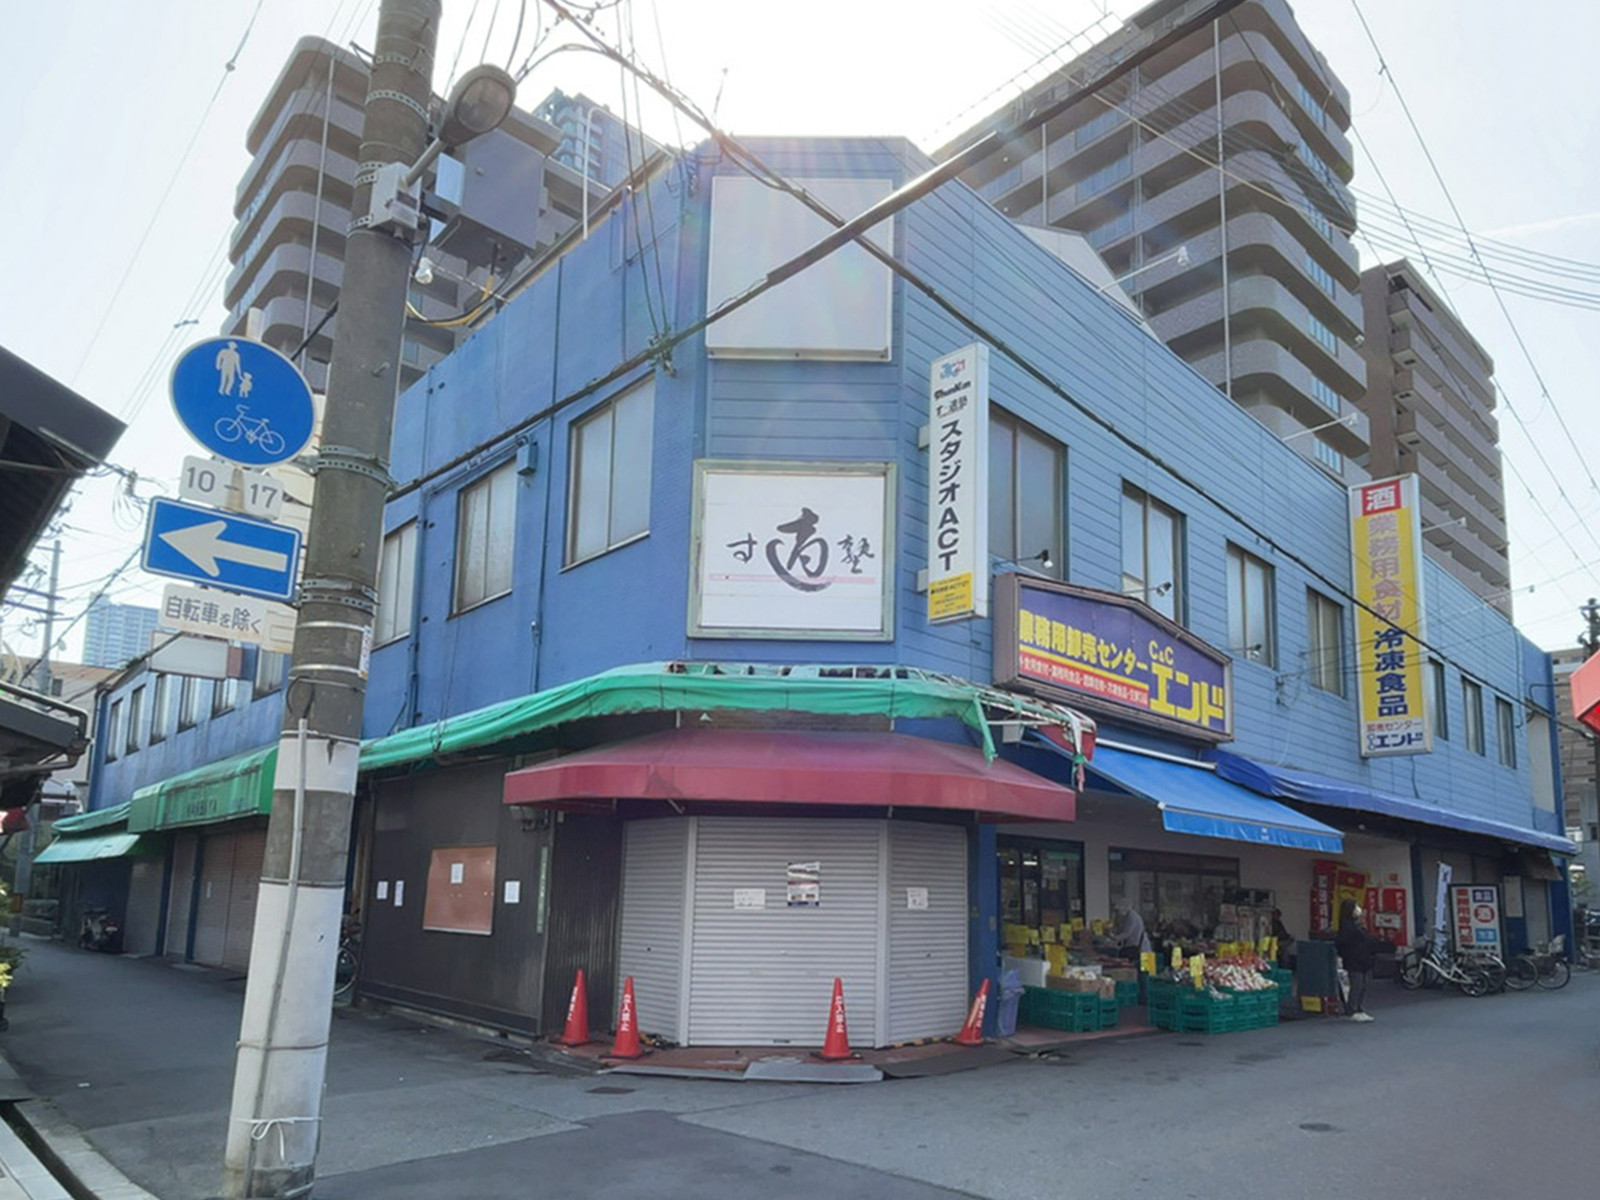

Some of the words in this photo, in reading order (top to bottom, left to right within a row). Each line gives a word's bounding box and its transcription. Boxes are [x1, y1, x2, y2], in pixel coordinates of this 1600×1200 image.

[938, 419, 962, 571] スタジオACT
[1365, 484, 1396, 512] 酒
[165, 596, 262, 635] 自転車を除く
[1150, 661, 1224, 727] エンド
[1373, 626, 1409, 717] 冷凍食品
[1374, 730, 1424, 750] エンド
